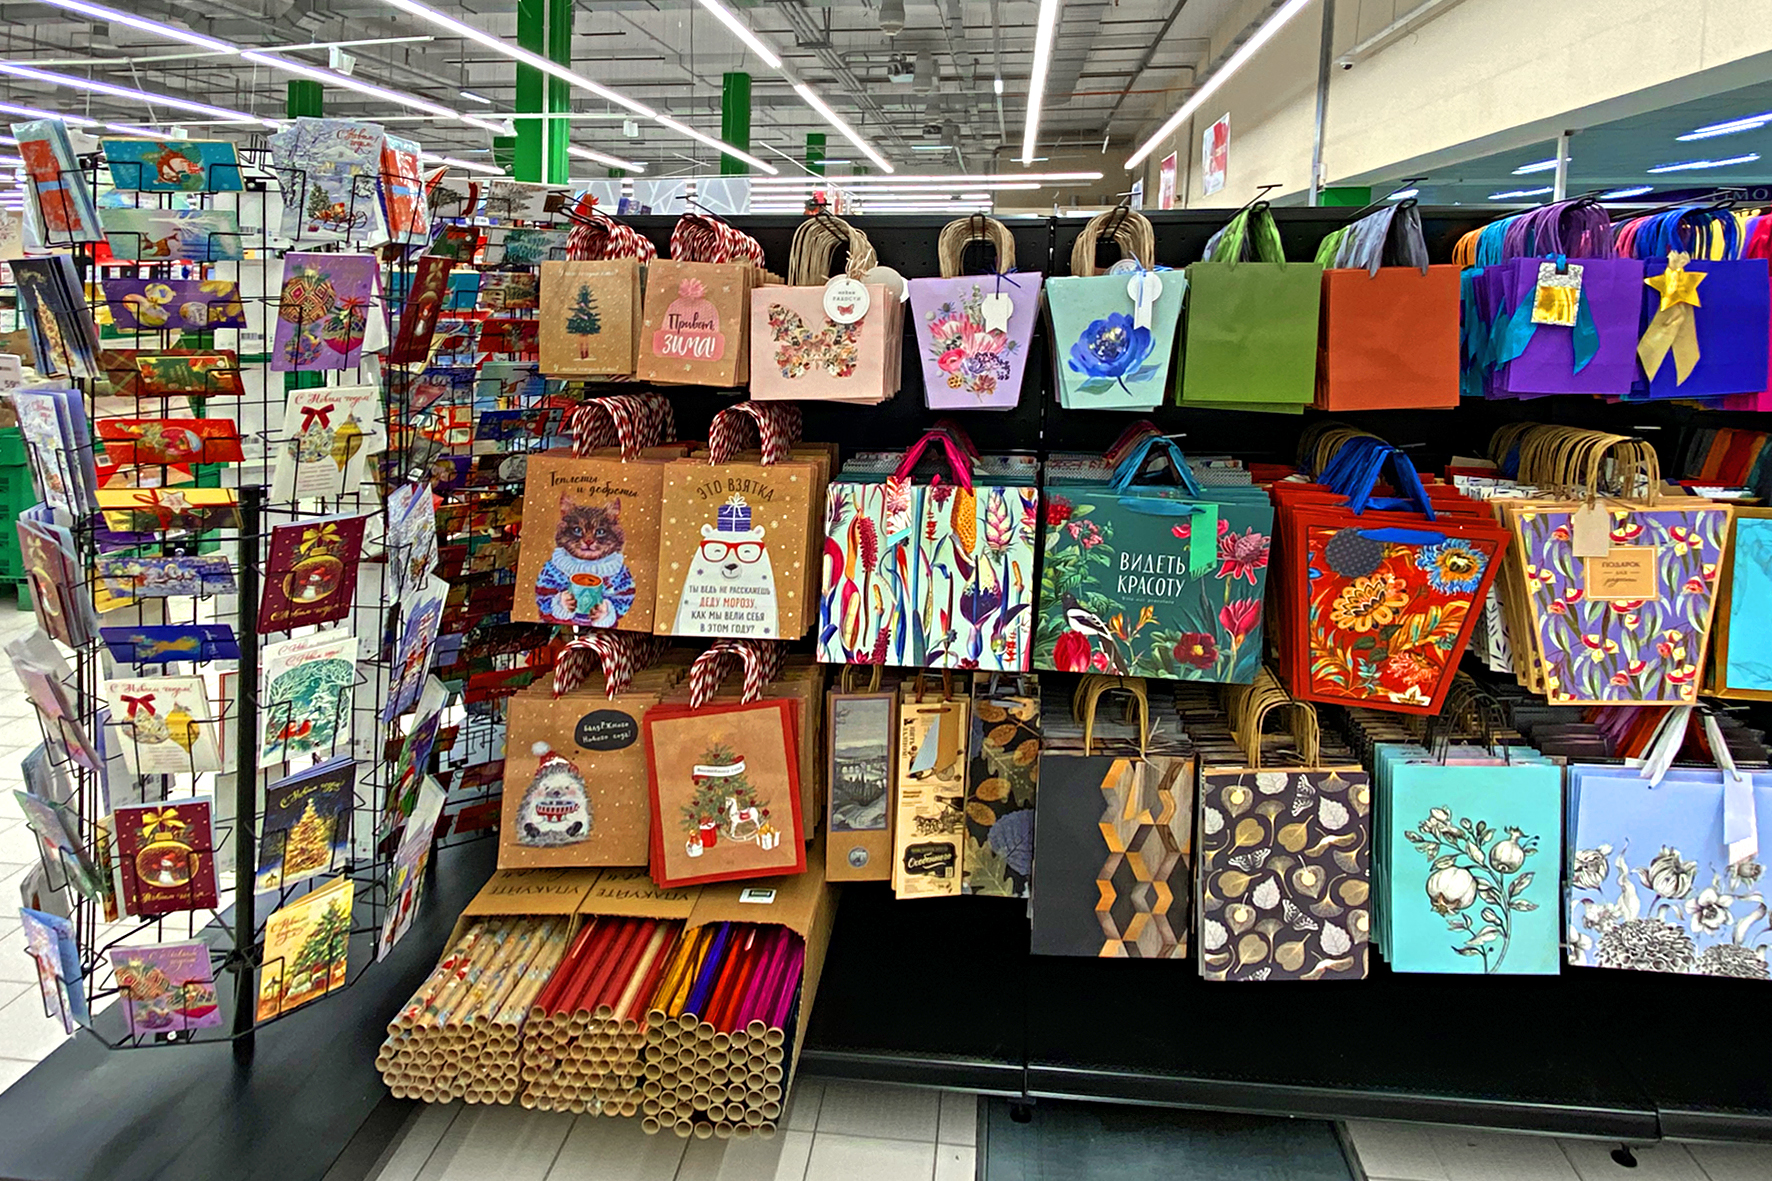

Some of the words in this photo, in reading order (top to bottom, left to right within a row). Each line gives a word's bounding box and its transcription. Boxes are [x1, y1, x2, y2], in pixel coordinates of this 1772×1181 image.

[696, 479, 723, 500] ЭТО
[727, 477, 775, 502] ВЗЯТКА
[1120, 551, 1187, 575] ВИДЕТЬ
[689, 585, 699, 593] ТЫ
[700, 585, 717, 594] ВЕДЬ
[719, 586, 728, 594] НЕ
[729, 586, 771, 595] РАССКАЖЕШЬ
[1117, 574, 1187, 598] КРАСОТУ
[699, 597, 720, 607] ДЕДУ
[691, 610, 706, 620] КАК
[708, 611, 722, 620] МЫ
[724, 611, 744, 621] ВЕЛИ
[746, 612, 765, 621] СЕБЯ
[700, 623, 706, 632] В
[708, 623, 729, 633] ЭТОМ
[731, 623, 755, 634] ГОДУ?
[488, 885, 579, 896] УПАКУЙТЕ
[596, 887, 689, 901] УПАКУЙТЕ
